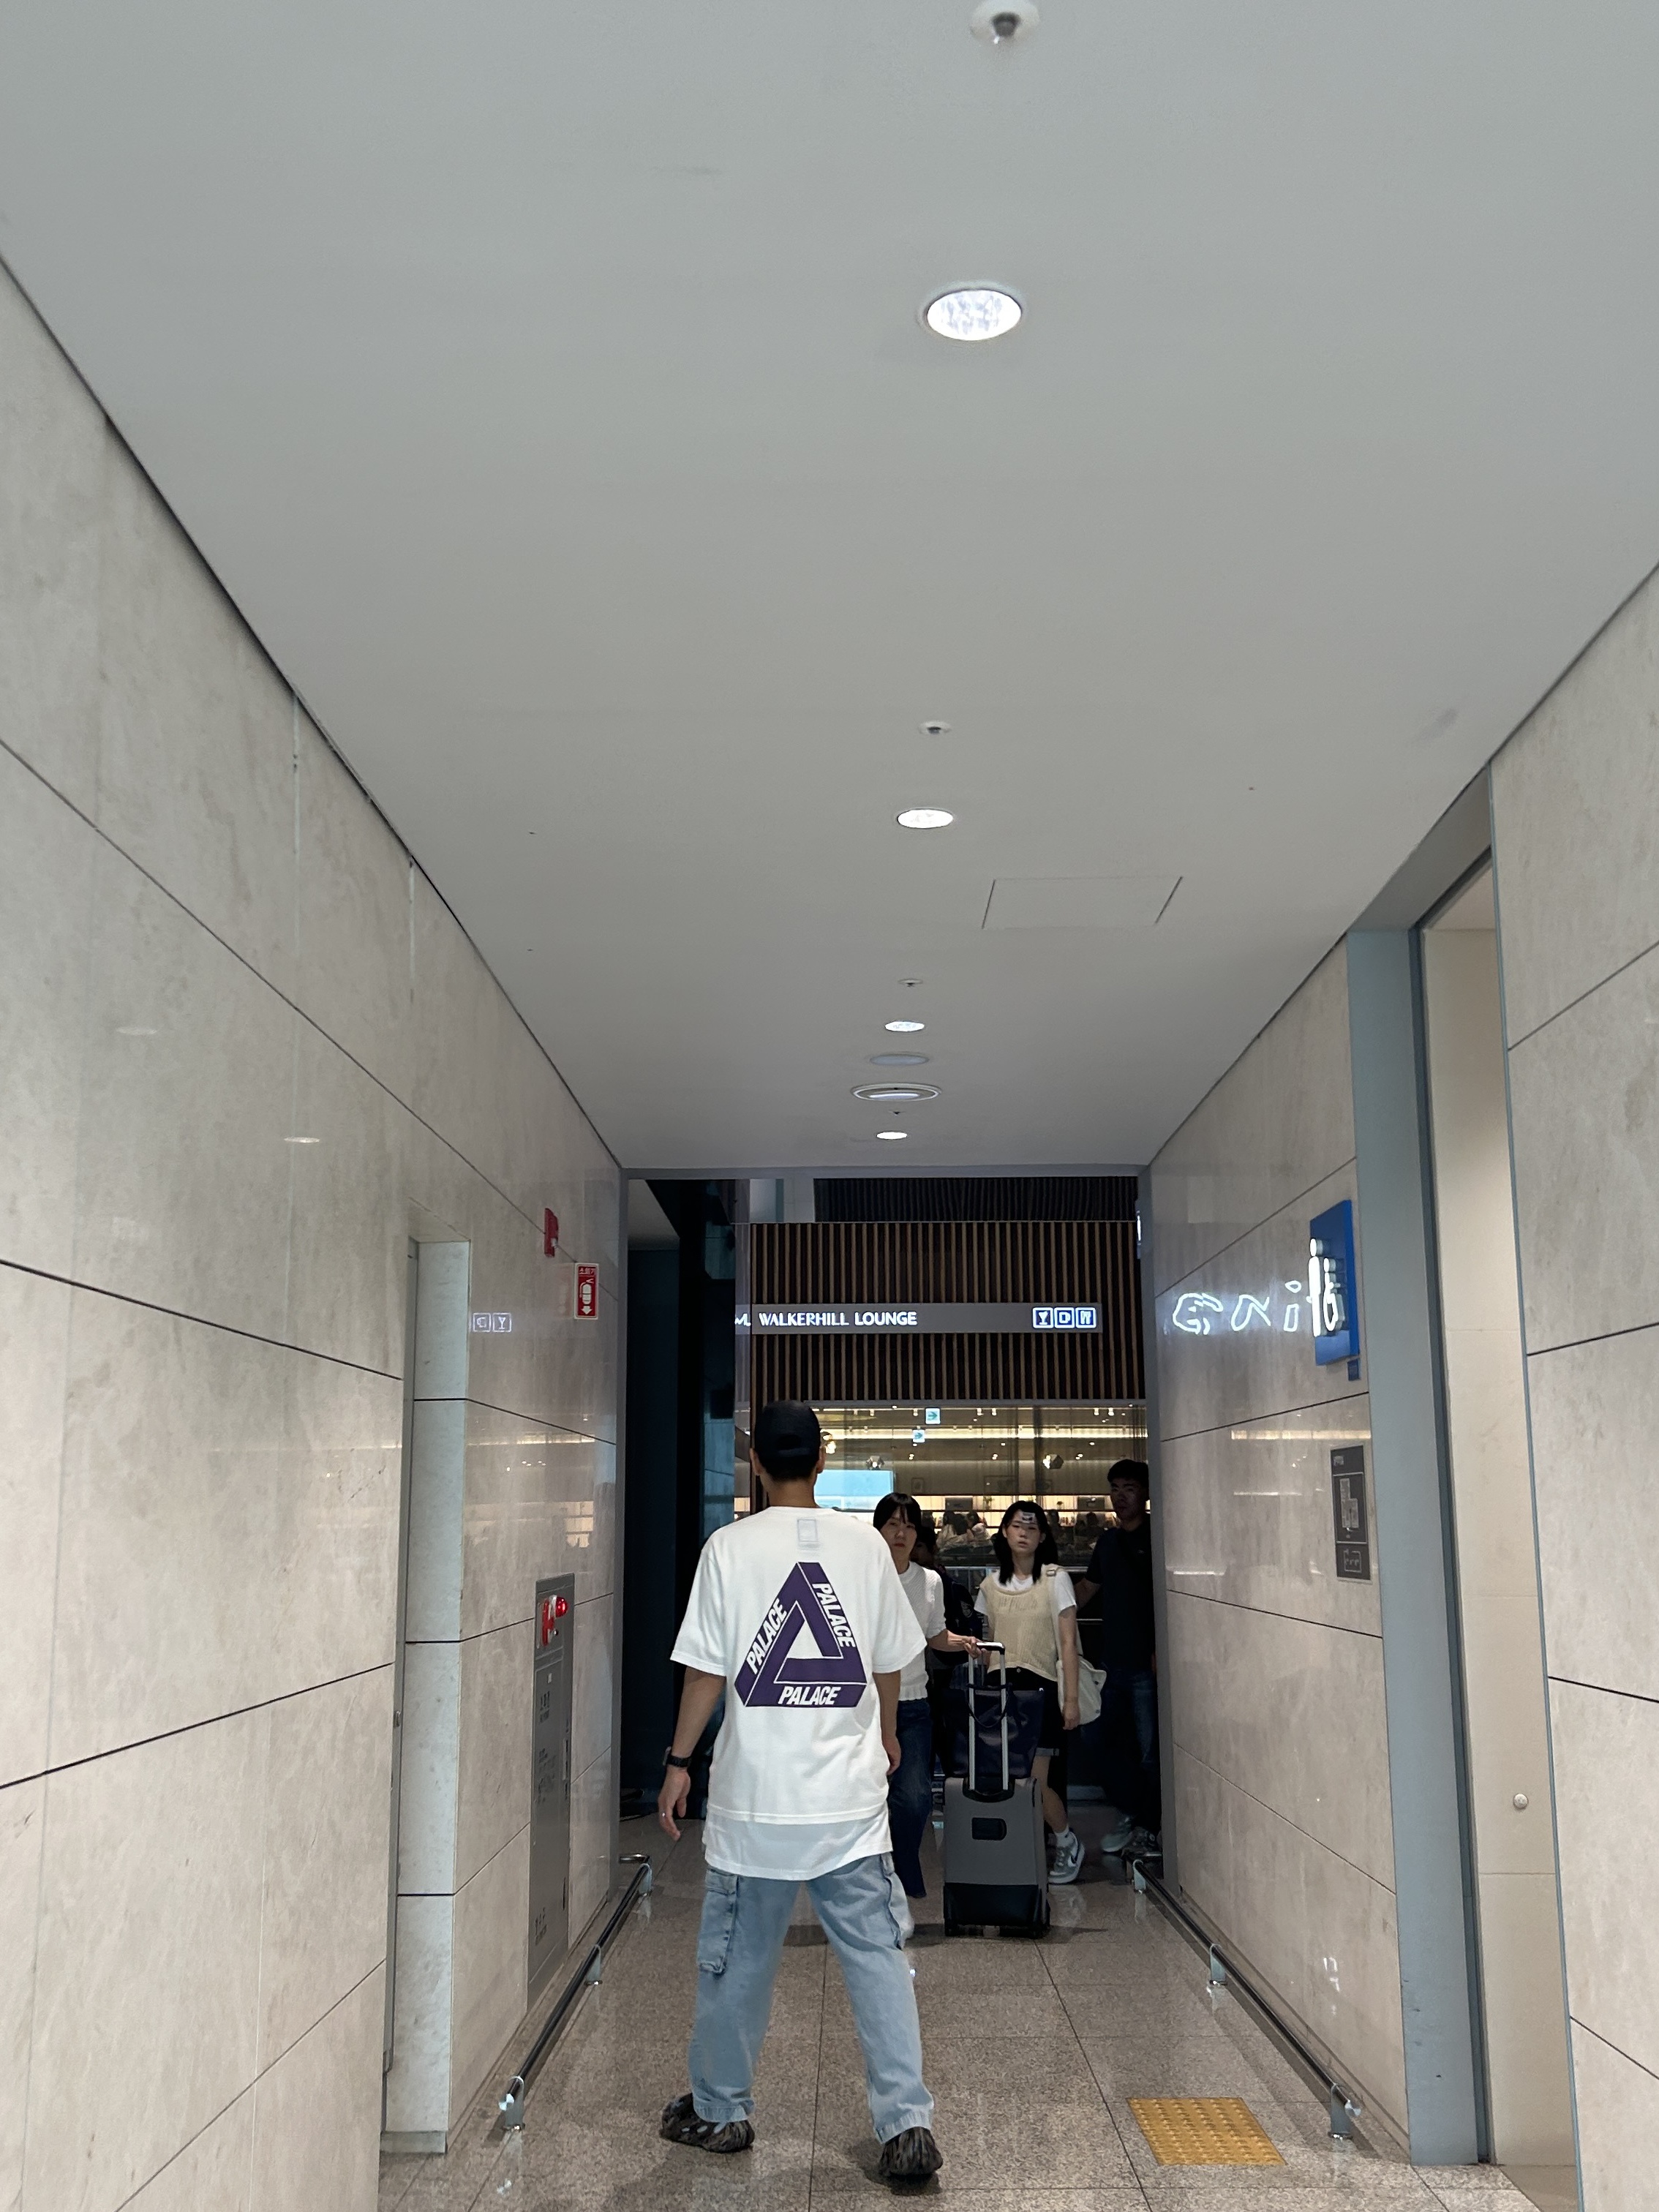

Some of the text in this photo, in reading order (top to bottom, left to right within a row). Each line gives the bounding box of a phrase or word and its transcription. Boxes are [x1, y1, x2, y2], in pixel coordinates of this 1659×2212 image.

[759, 1312, 850, 1326] WALKERHILL
[854, 1312, 918, 1325] LOUNGE
[746, 1598, 788, 1674] PALACE
[812, 1583, 855, 1648] PALACE
[778, 1686, 841, 1705] PALACE
